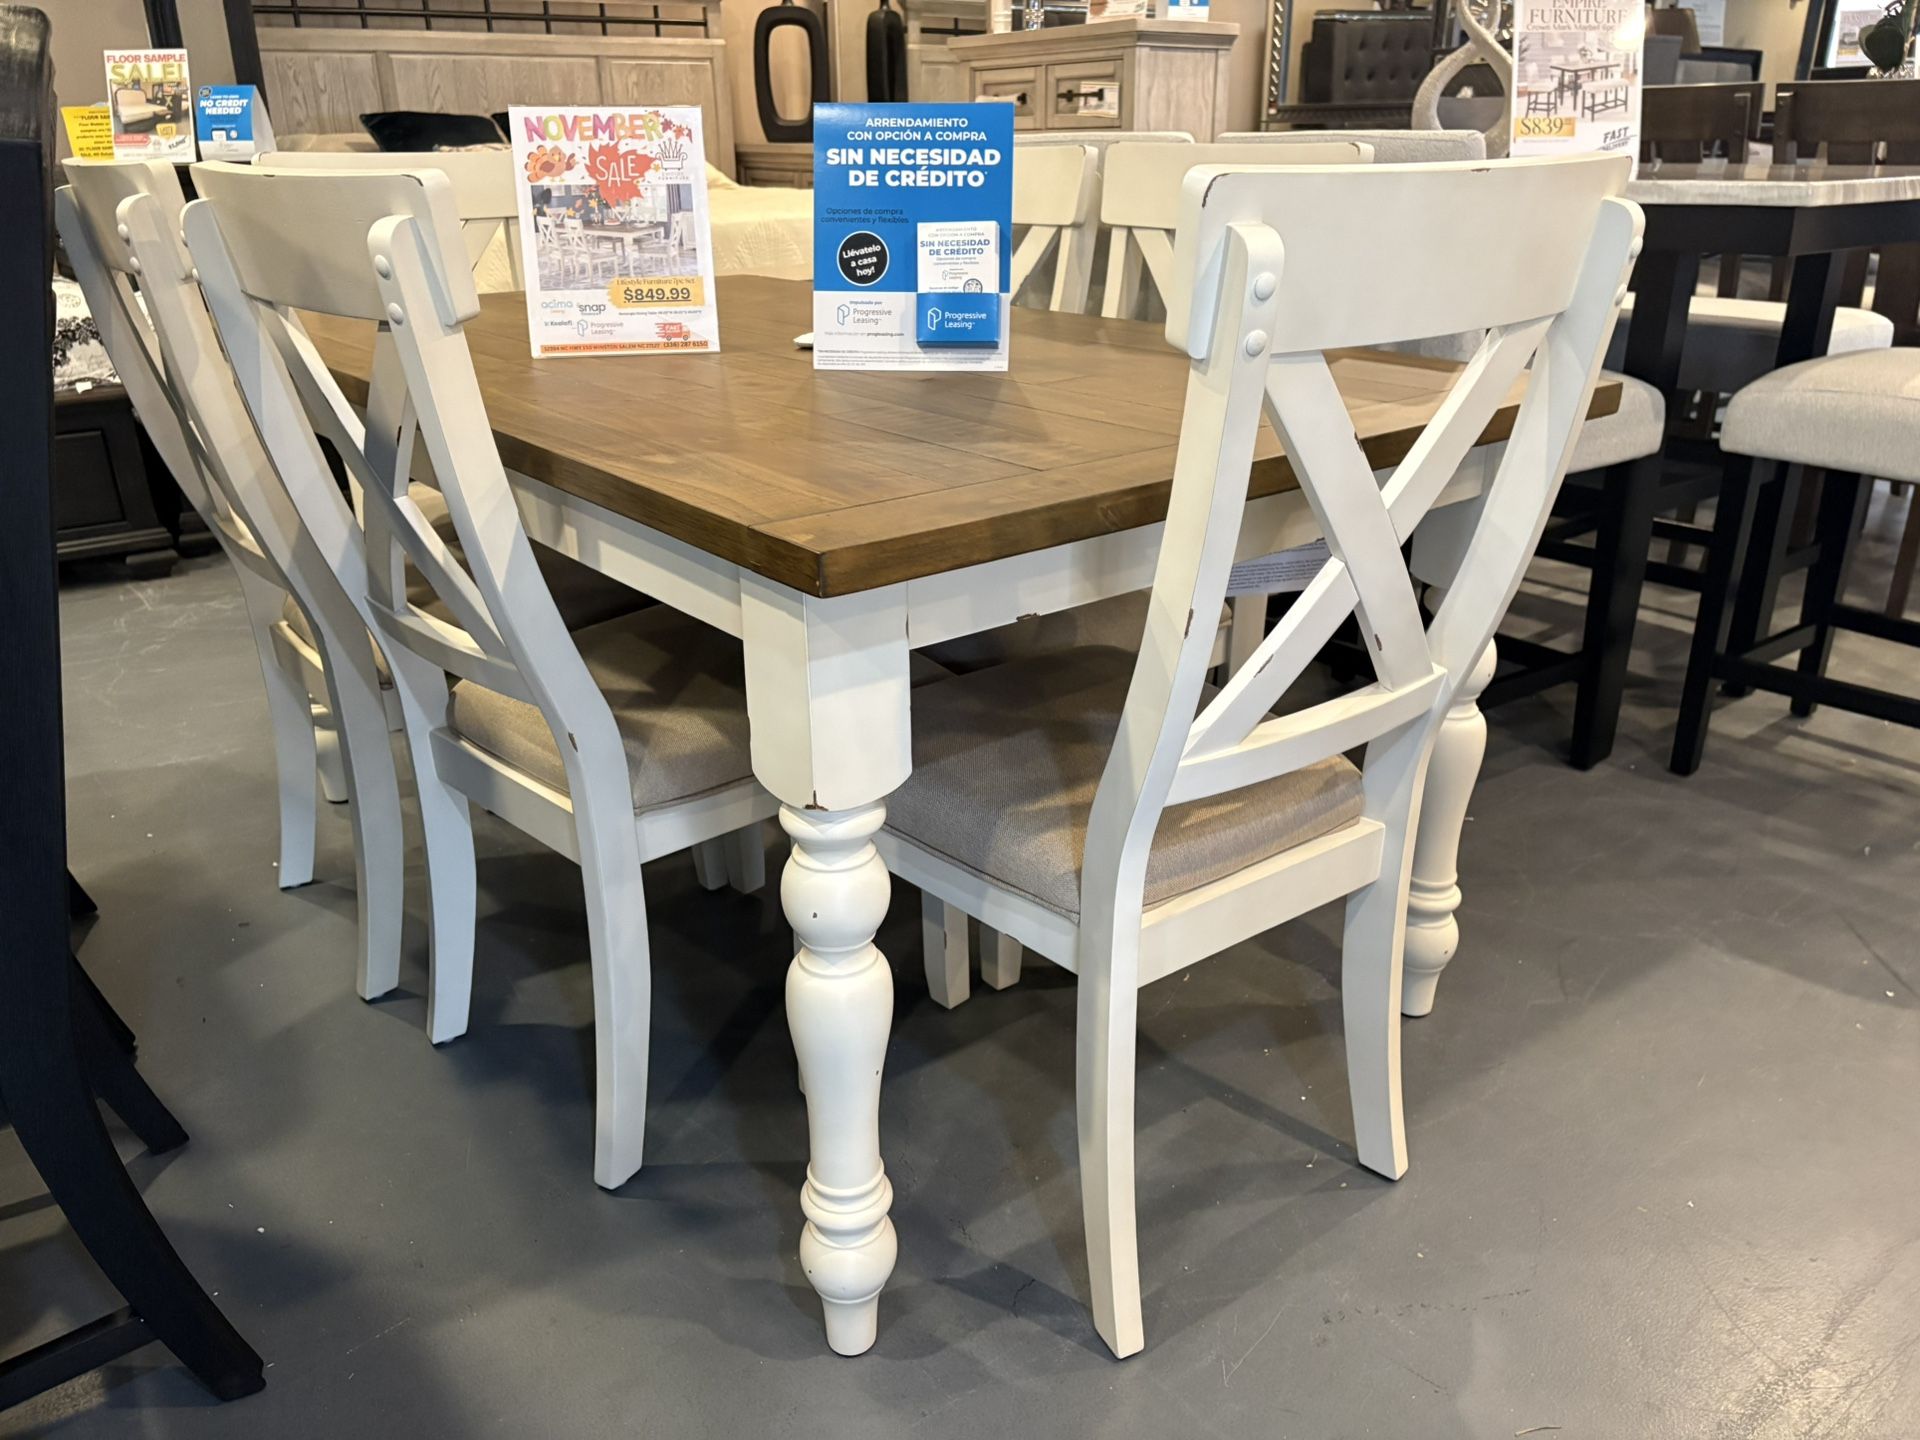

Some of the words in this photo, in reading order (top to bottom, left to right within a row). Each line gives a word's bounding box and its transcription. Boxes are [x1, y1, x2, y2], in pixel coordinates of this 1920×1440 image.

[106, 54, 142, 64] FLOOR
[144, 53, 186, 63] SAMPLE
[200, 99, 214, 107] NO
[215, 99, 249, 107] CREDIT
[205, 107, 243, 115] NEEDED
[524, 112, 664, 143] NOVEMBER
[865, 117, 968, 128] ARRENDAMIENTO
[1520, 117, 1564, 136] $839
[846, 131, 873, 142] CON
[875, 129, 922, 142] OPCIÓN
[924, 131, 933, 141] A
[935, 131, 987, 141] COMPRA
[1602, 126, 1630, 144] FAST
[826, 148, 862, 166] SIN
[870, 148, 1001, 166] NECESIDAD
[596, 154, 641, 188] SALE
[848, 170, 879, 187] DE
[826, 207, 861, 215] Opciones
[874, 208, 904, 216] compra
[920, 240, 935, 248] SIN
[937, 238, 991, 247] NECESIDAD
[842, 244, 881, 259] Llévatelo
[928, 248, 942, 256] DE
[943, 246, 984, 256] CRÉDITO
[857, 256, 877, 266] casa
[856, 265, 875, 277] hoy!
[623, 287, 692, 303] $849.99
[541, 299, 573, 309] acima
[578, 304, 606, 315] snap
[853, 308, 893, 317] Progressive
[944, 311, 987, 321] Progressive
[590, 321, 624, 329] Progressive
